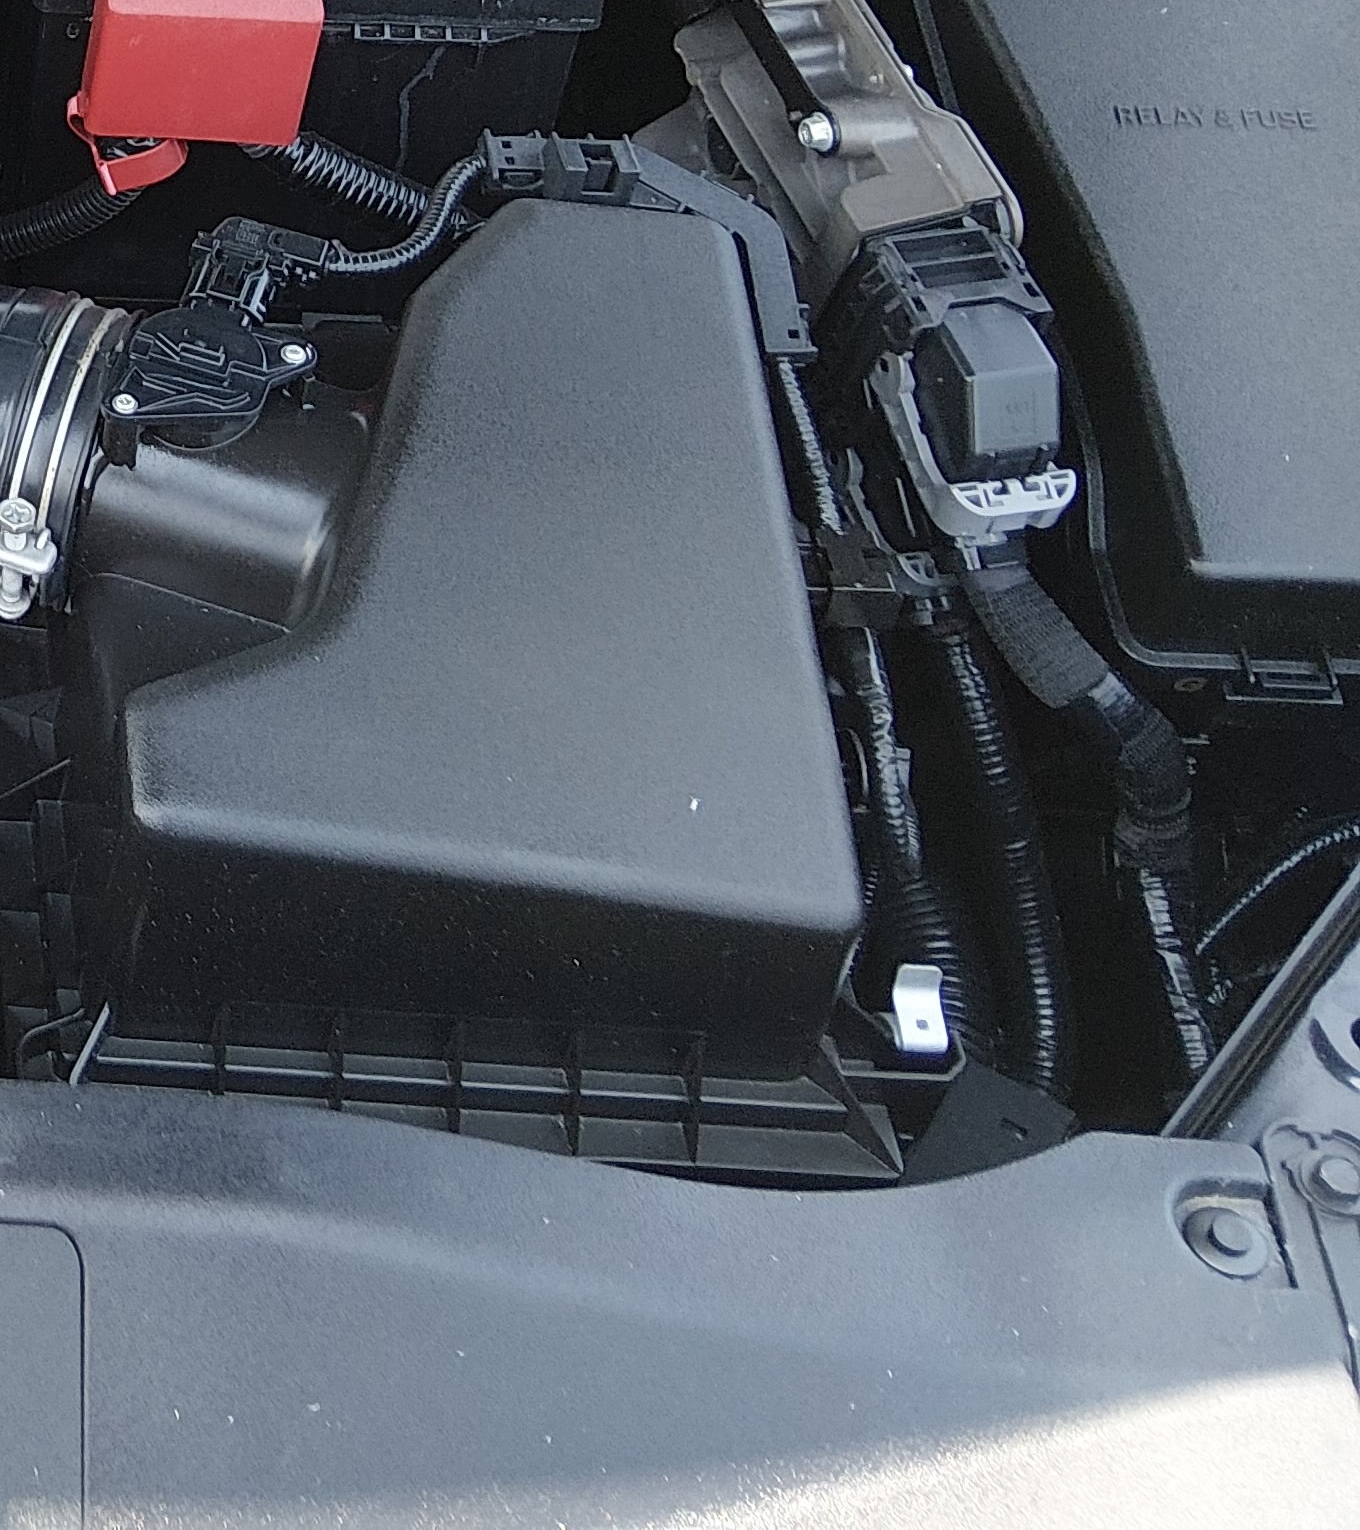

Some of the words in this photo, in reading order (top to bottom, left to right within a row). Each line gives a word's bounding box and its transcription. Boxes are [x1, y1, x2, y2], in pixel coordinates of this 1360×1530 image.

[1113, 103, 1206, 128] RELAY
[1213, 109, 1232, 129] &
[1240, 108, 1318, 132] FUSE
